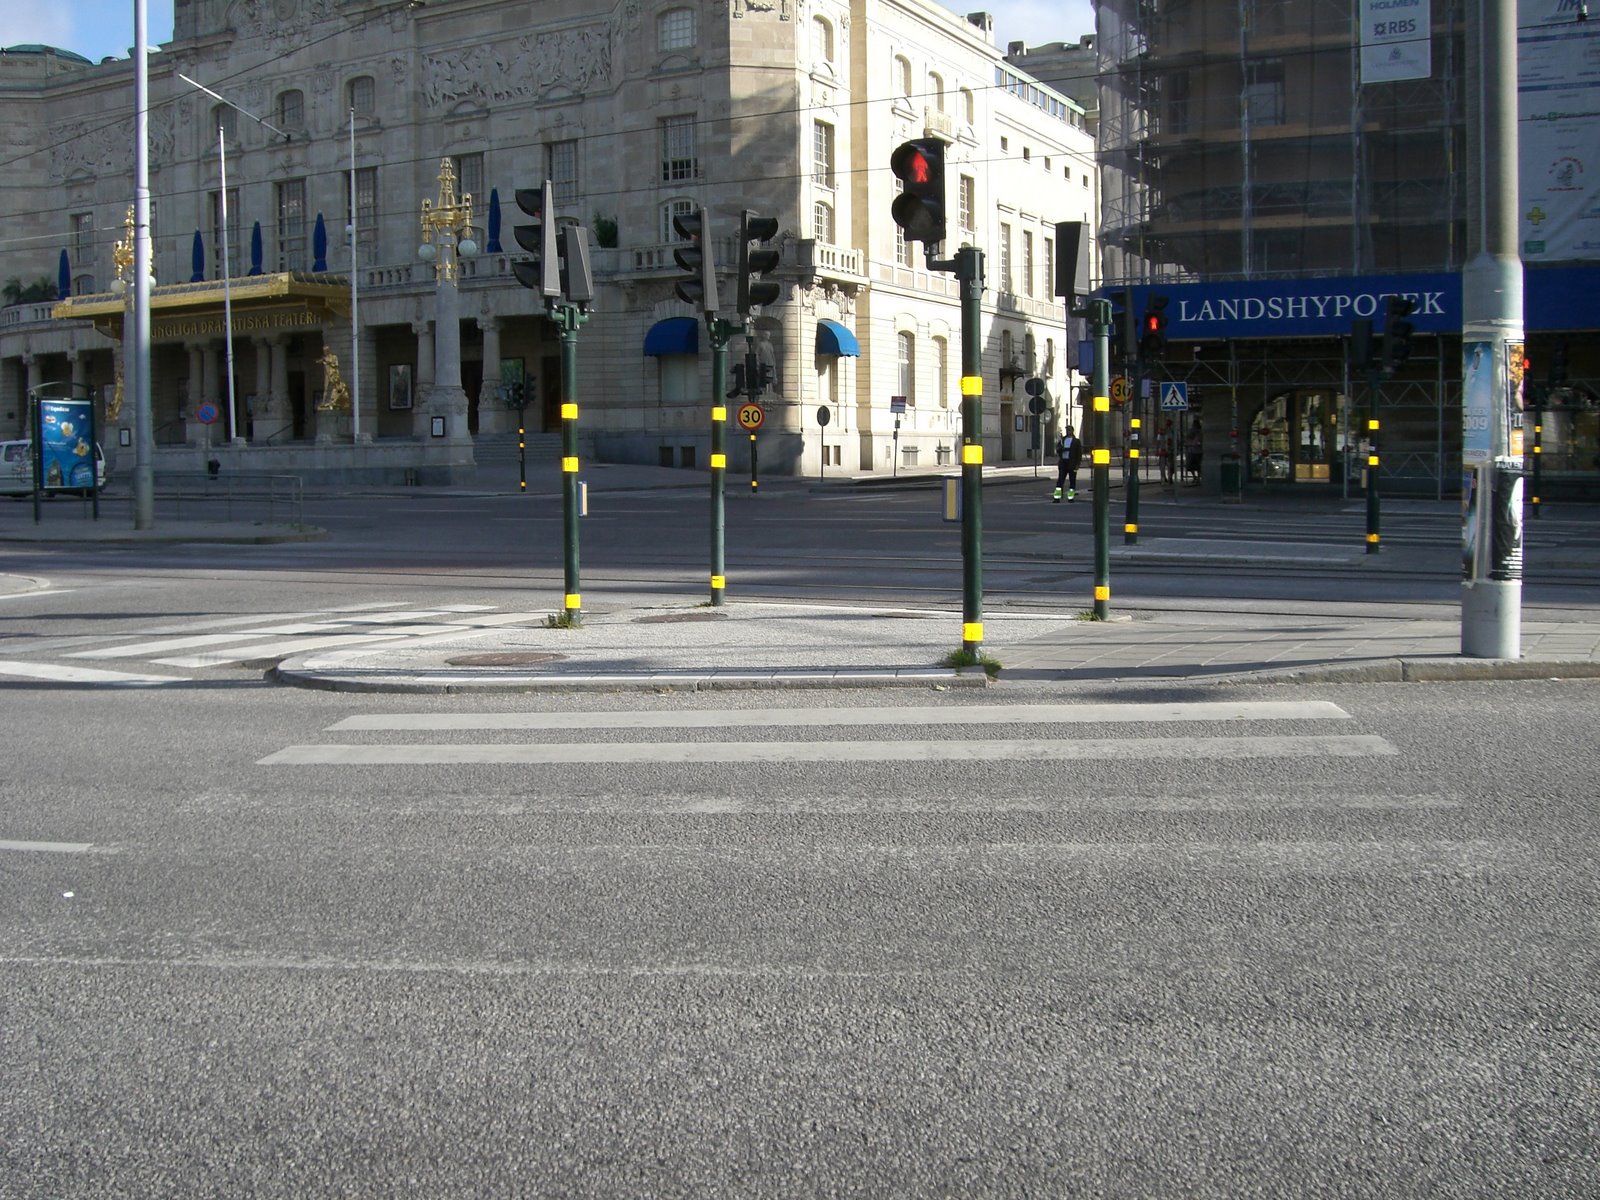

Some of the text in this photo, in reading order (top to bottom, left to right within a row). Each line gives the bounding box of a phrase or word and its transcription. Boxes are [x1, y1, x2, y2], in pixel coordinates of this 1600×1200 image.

[1370, 0, 1419, 10] HOLMEN
[1388, 18, 1416, 34] RBS
[1179, 291, 1446, 322] LANDSHYPOTEK
[1114, 384, 1131, 396] 30
[742, 410, 761, 423] 30
